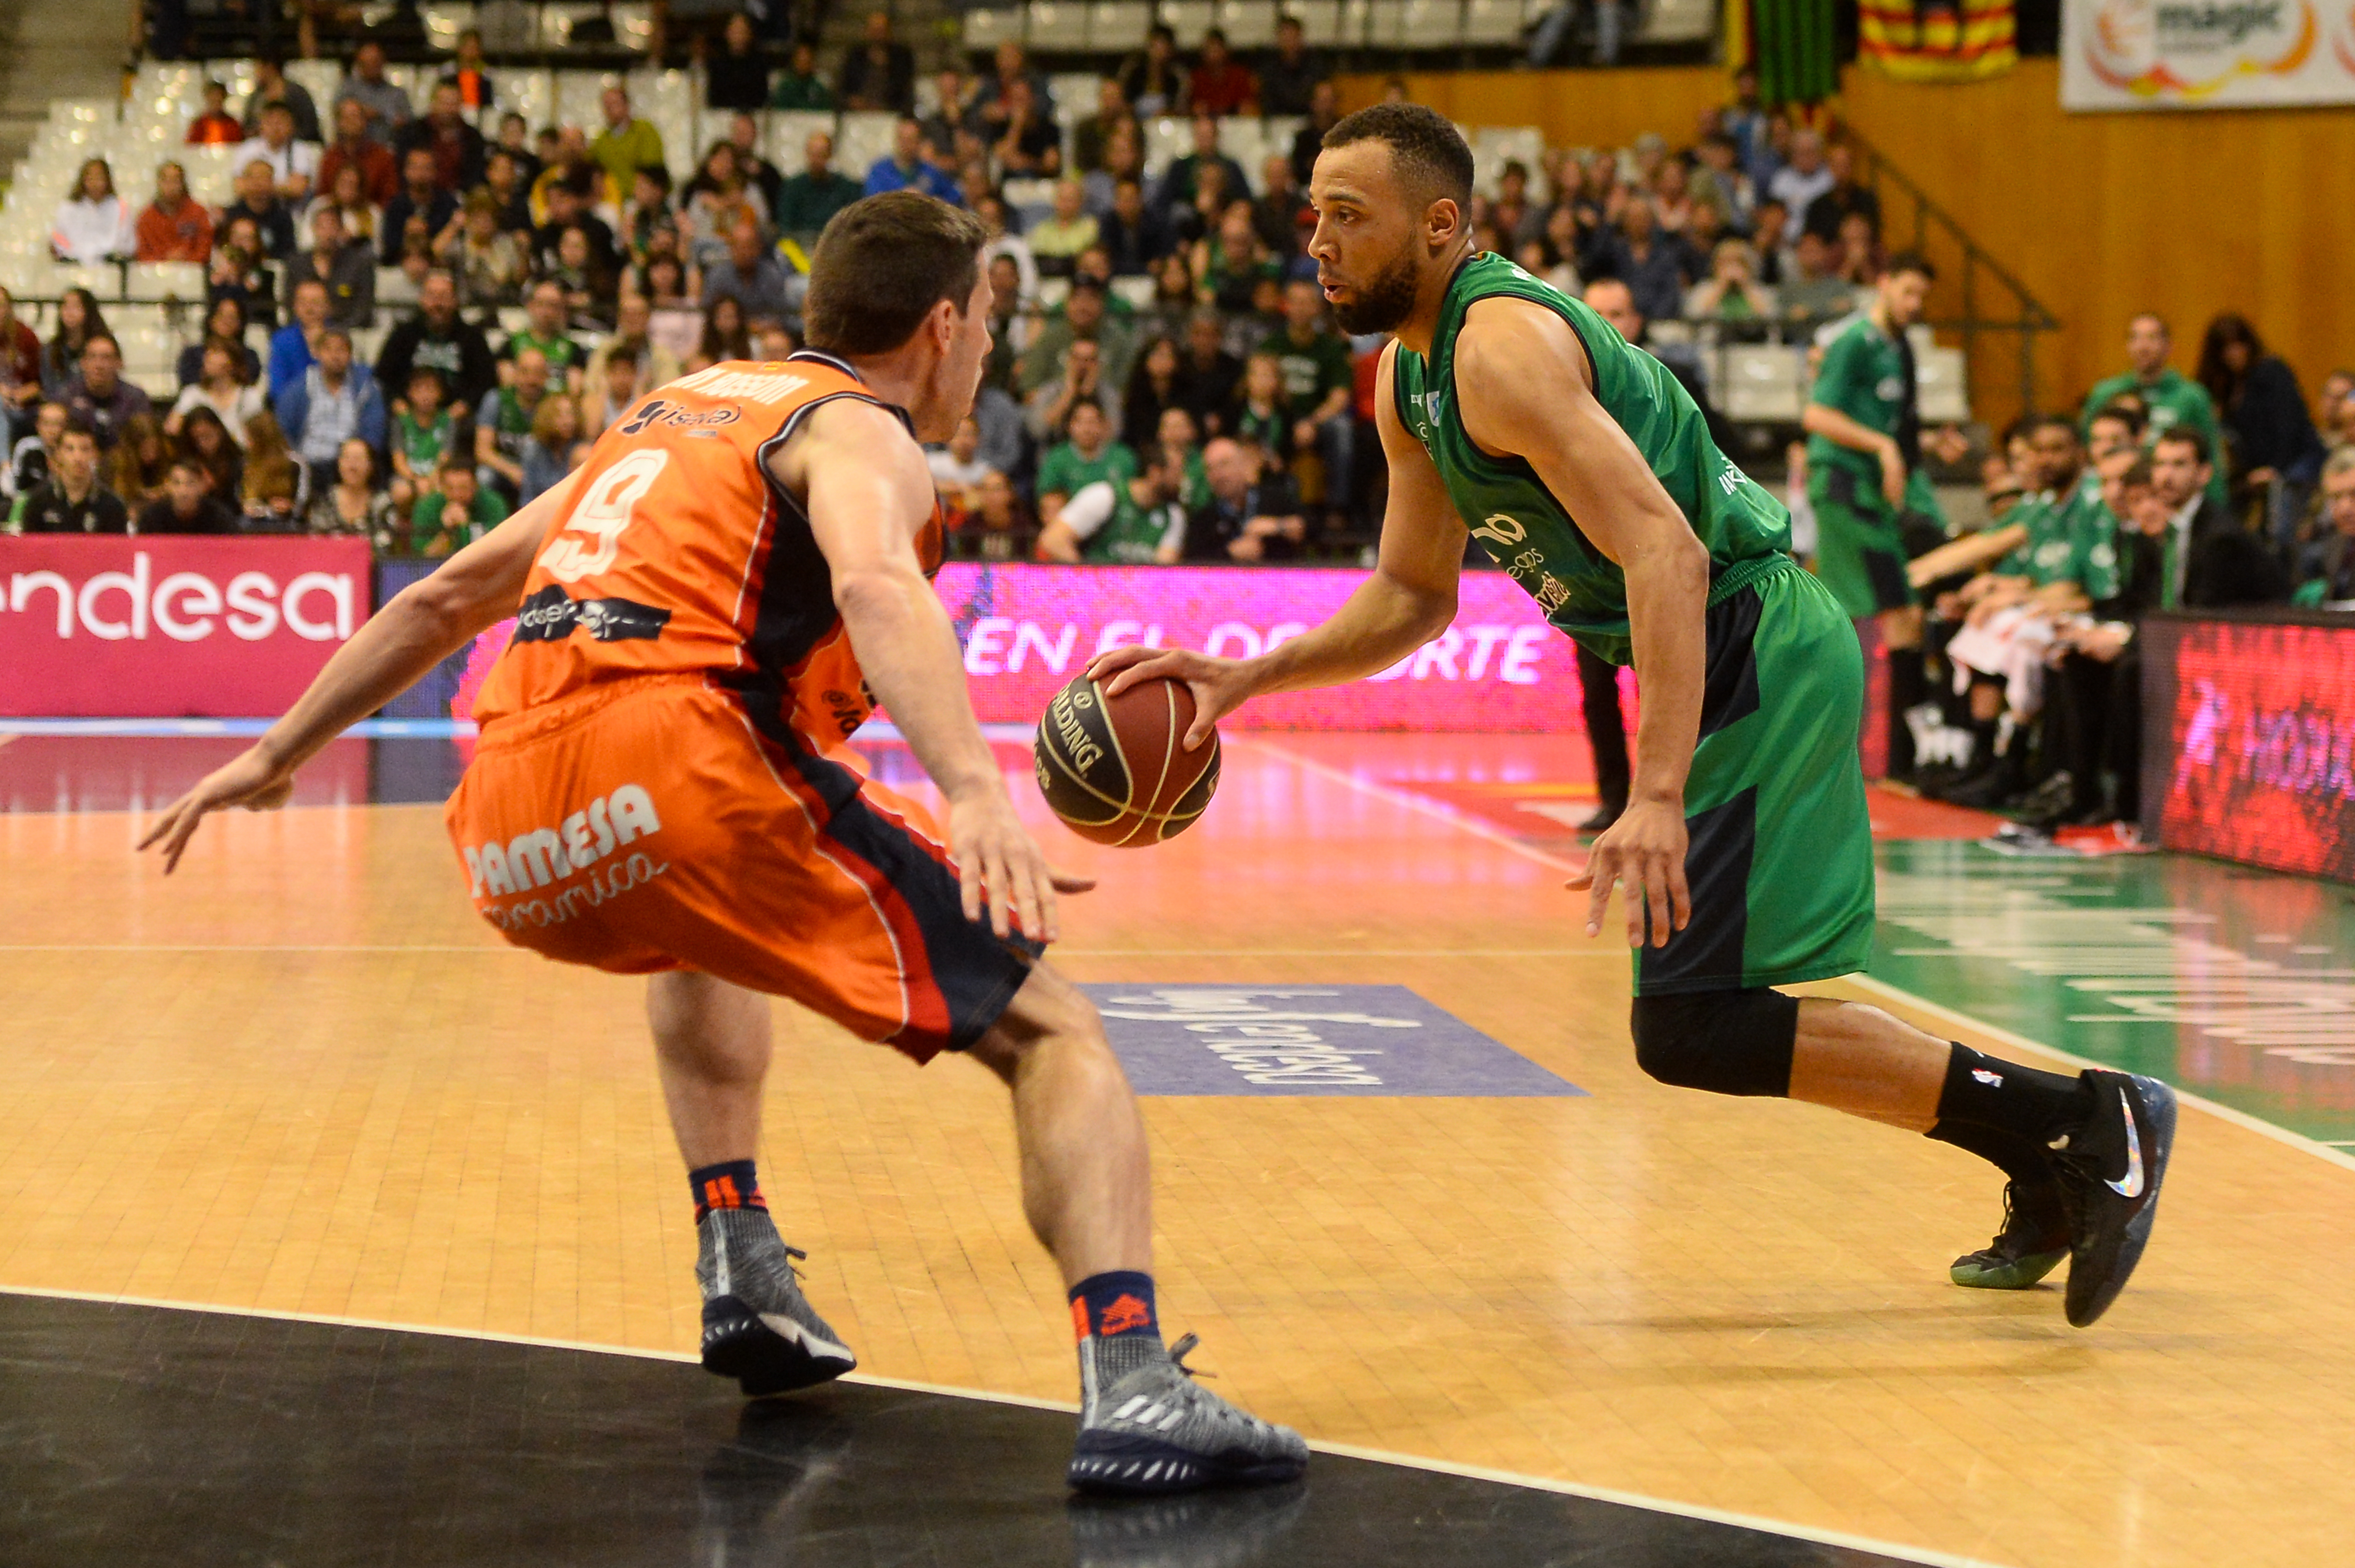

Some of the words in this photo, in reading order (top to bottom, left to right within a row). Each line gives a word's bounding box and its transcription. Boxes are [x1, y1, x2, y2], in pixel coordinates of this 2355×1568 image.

[539, 449, 669, 584] 9
[0, 551, 355, 641] ndesa
[964, 616, 1078, 676] EN
